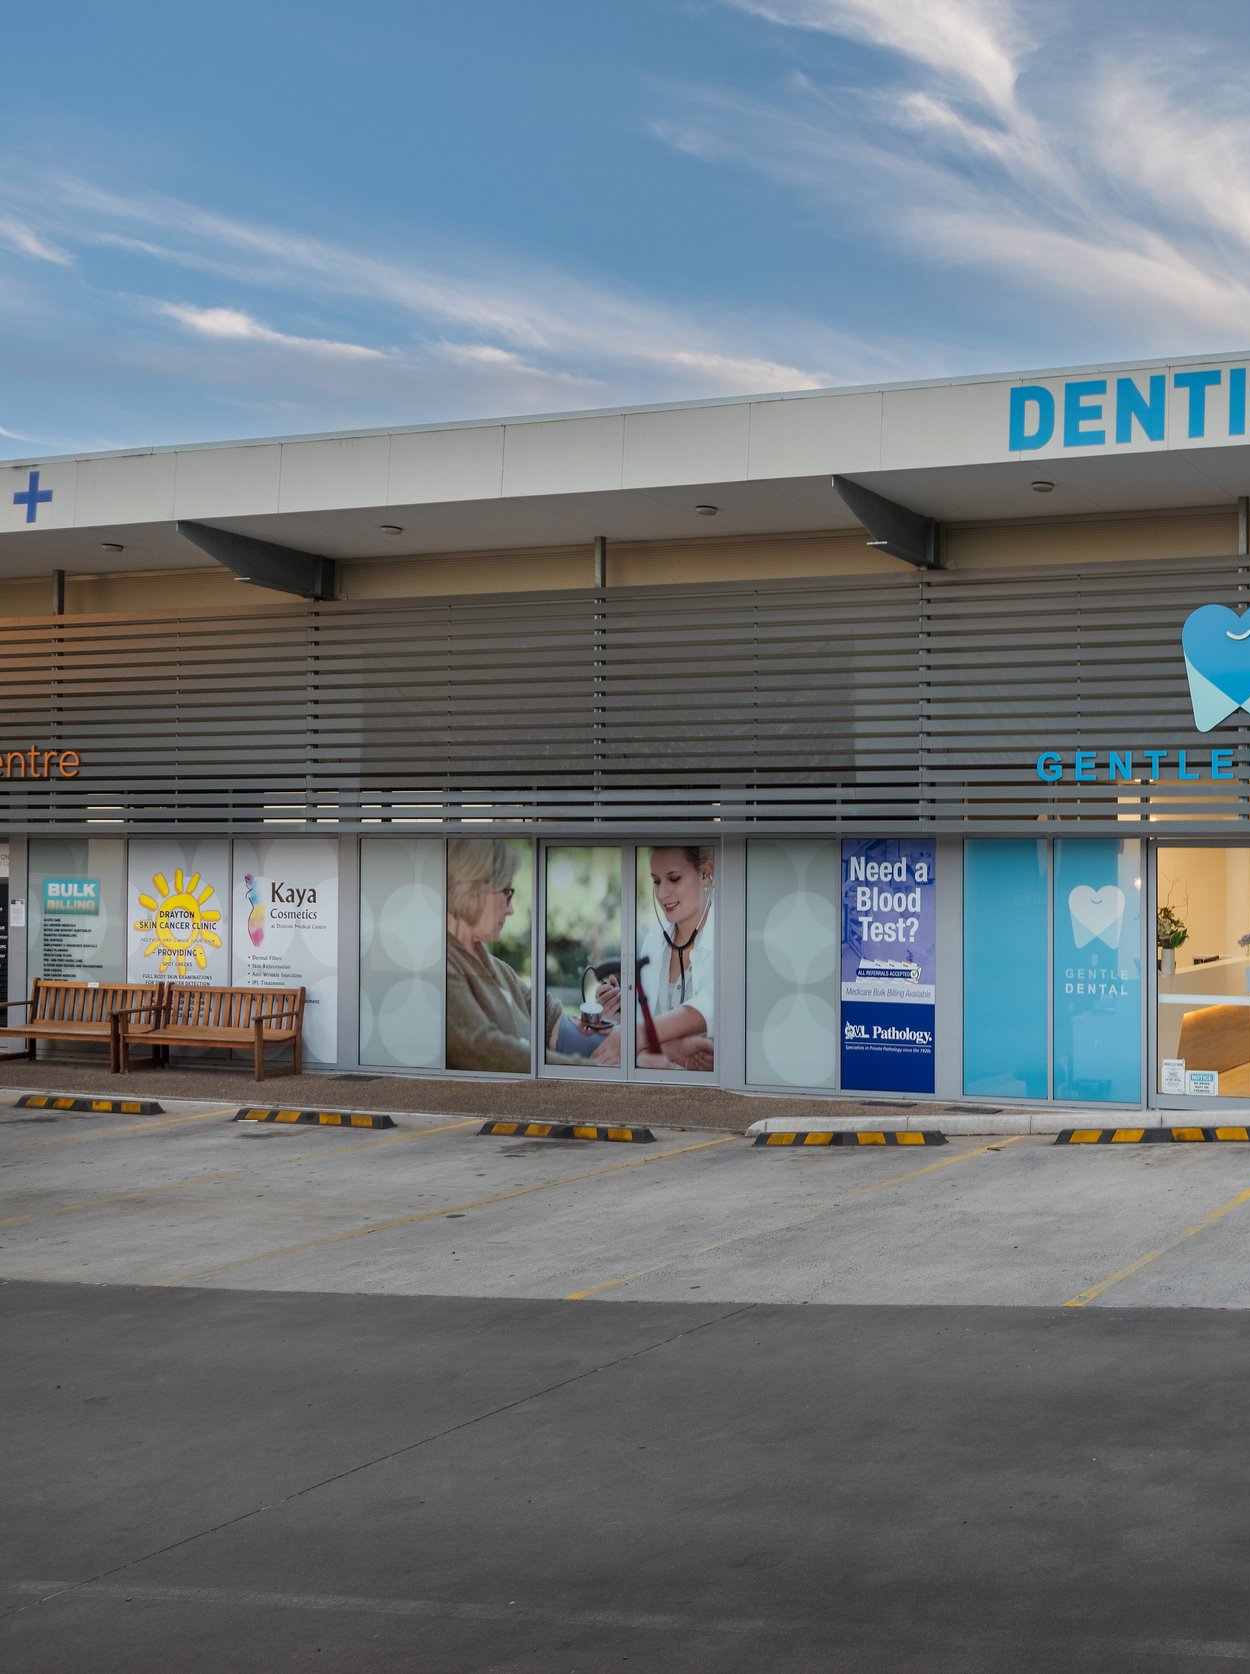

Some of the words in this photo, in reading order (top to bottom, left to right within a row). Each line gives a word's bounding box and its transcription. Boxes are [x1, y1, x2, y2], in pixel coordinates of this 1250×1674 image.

[0, 744, 80, 777] ntre
[1036, 749, 1235, 782] GENTLE
[850, 857, 906, 881] Need
[915, 862, 928, 882] a
[48, 883, 96, 897] BULK
[271, 882, 316, 907] Kaya
[47, 899, 96, 911] BILLING
[857, 886, 921, 912] Blood
[160, 910, 194, 918] DRAYTON
[270, 908, 317, 919] Cosmetics
[192, 922, 216, 930] CLINIC
[859, 916, 919, 942] Test?
[1066, 969, 1128, 980] GENTLE
[846, 987, 872, 997] Medicare
[872, 988, 886, 997] Bulk
[887, 988, 905, 998] Billing
[905, 990, 932, 998] Available
[1065, 984, 1128, 995] DENTAL
[872, 1026, 932, 1044] Pathology.
